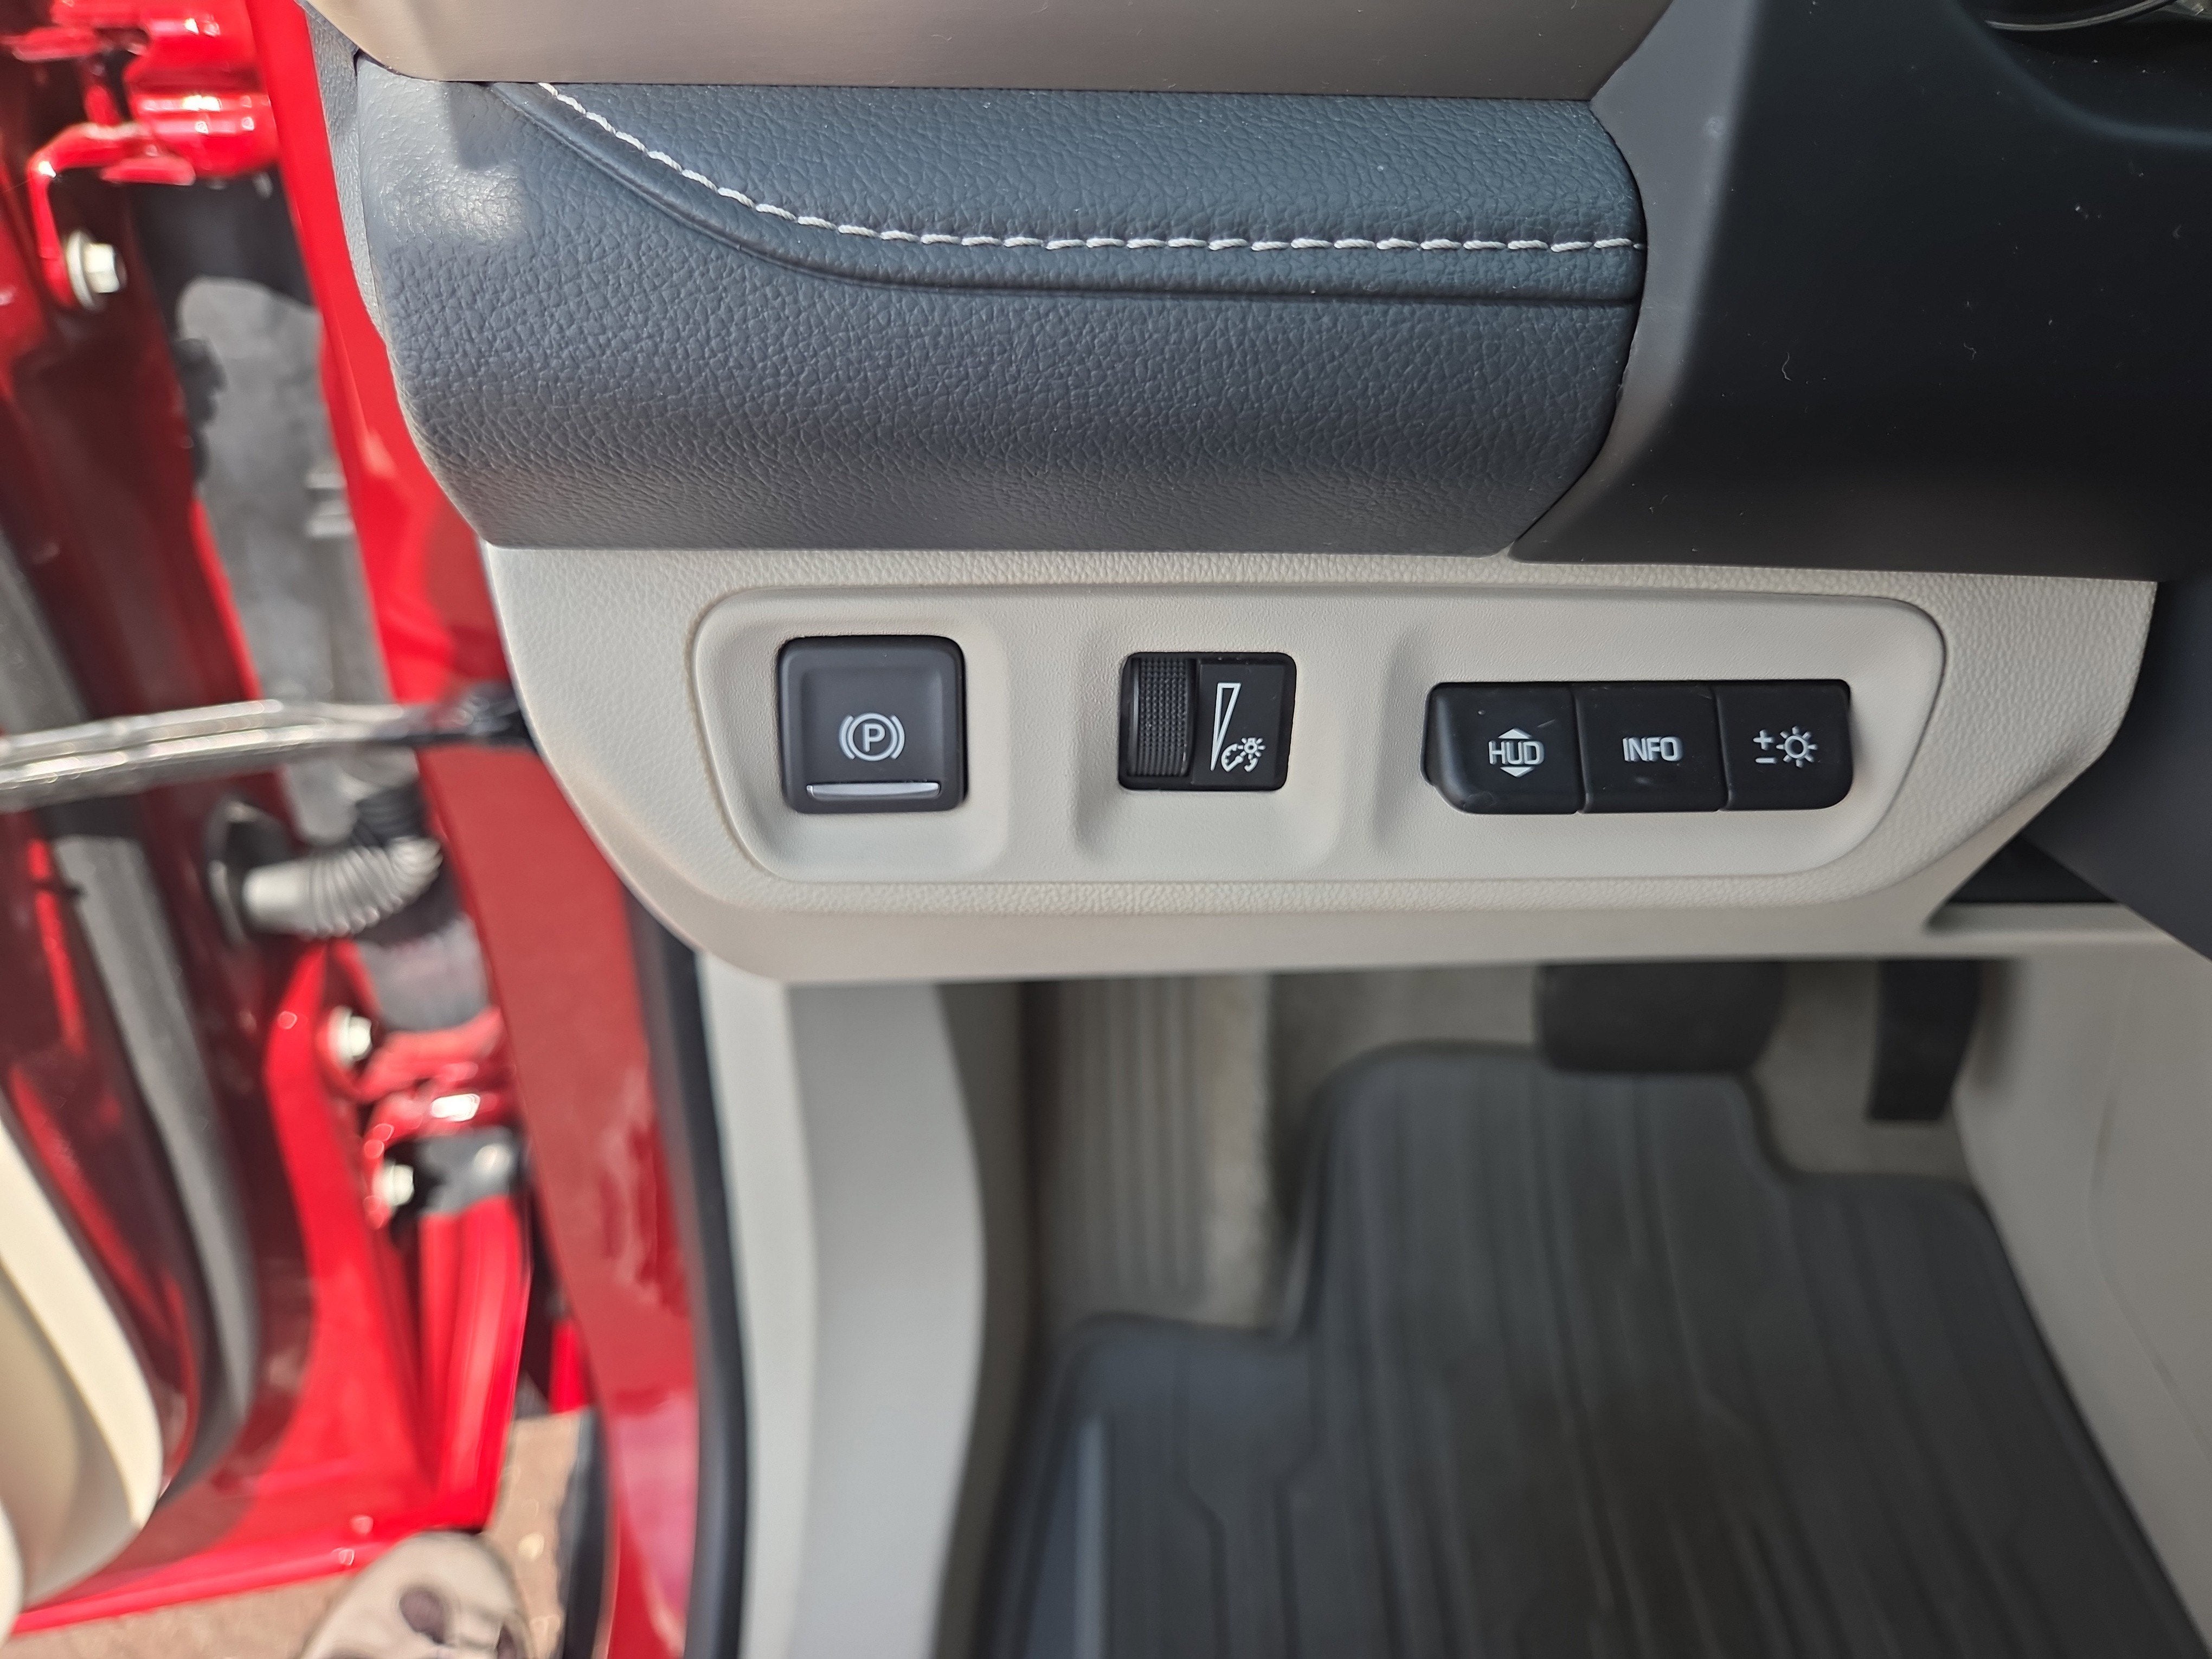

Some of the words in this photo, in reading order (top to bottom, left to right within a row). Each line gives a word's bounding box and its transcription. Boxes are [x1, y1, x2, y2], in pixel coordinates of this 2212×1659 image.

[863, 724, 885, 751] P
[1622, 737, 1680, 762] INFO
[1488, 741, 1544, 765] HUD
